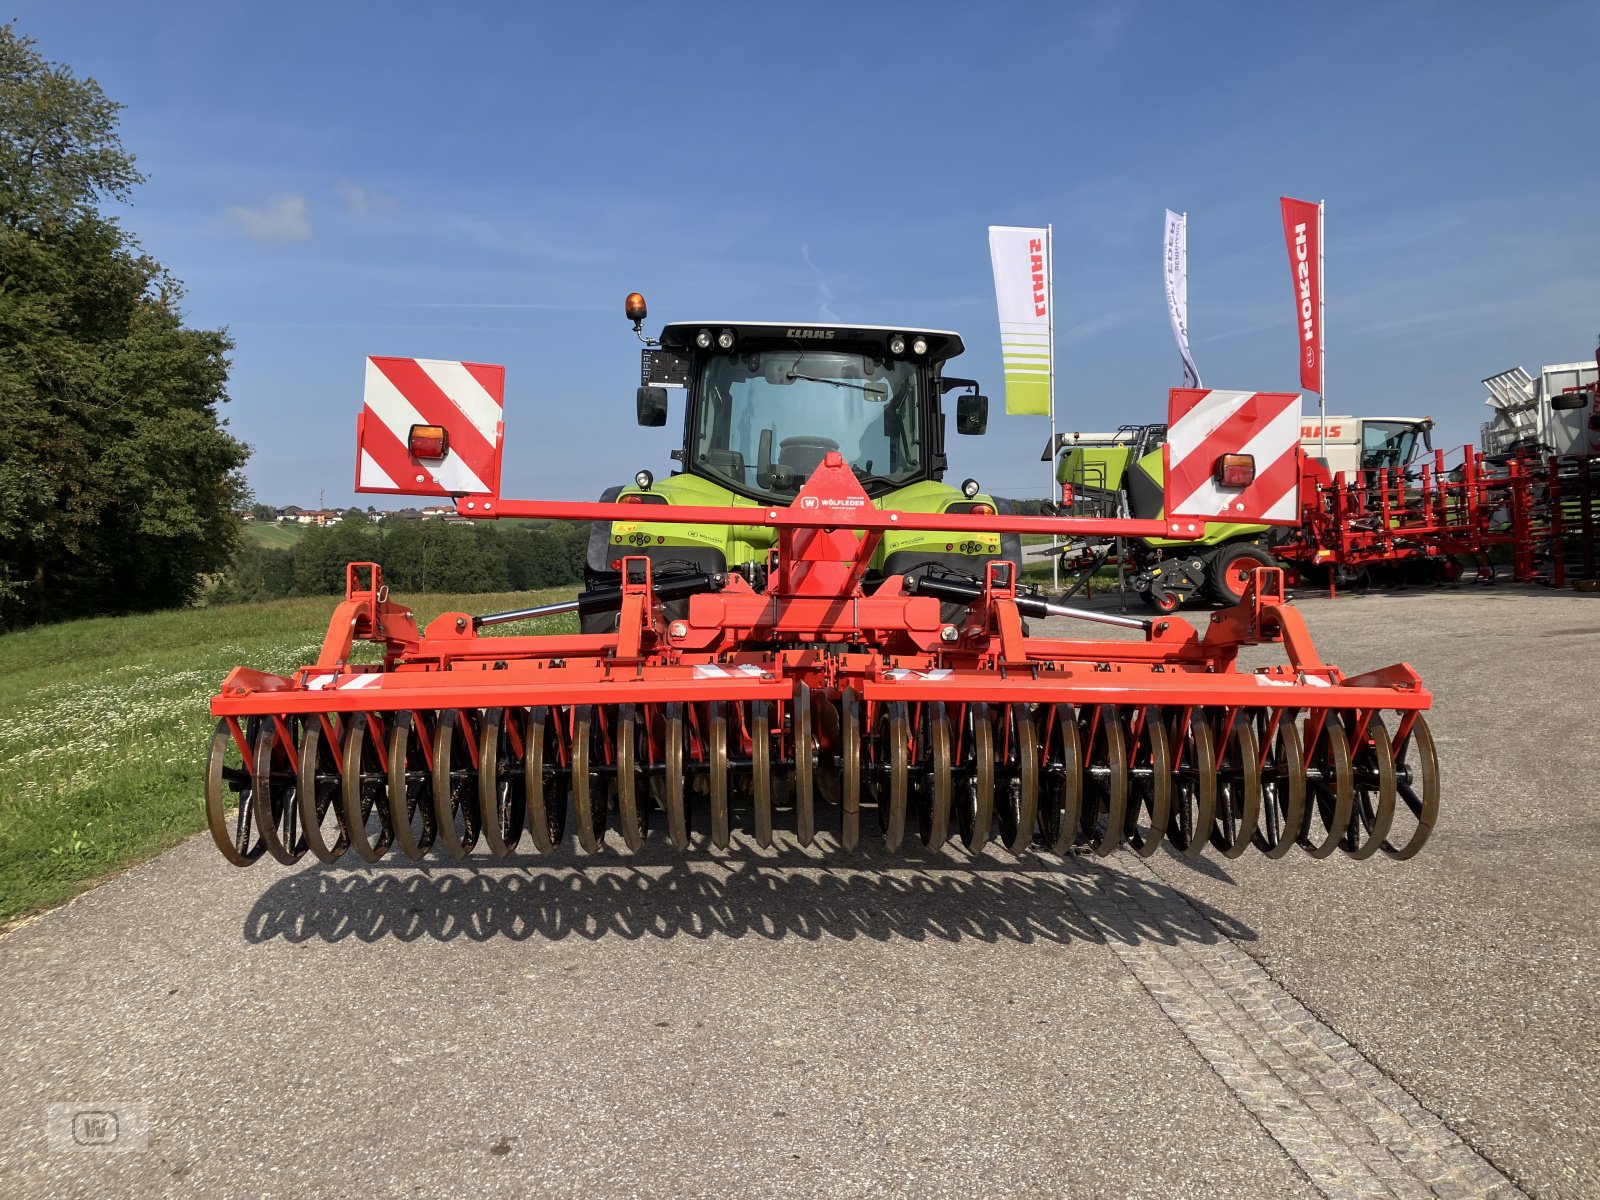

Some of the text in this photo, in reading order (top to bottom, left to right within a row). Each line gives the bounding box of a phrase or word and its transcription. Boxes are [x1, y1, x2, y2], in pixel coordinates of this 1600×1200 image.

[786, 328, 835, 340] CLAAS
[1300, 425, 1342, 439] AAS
[821, 498, 865, 507] WÖLFLEDER
